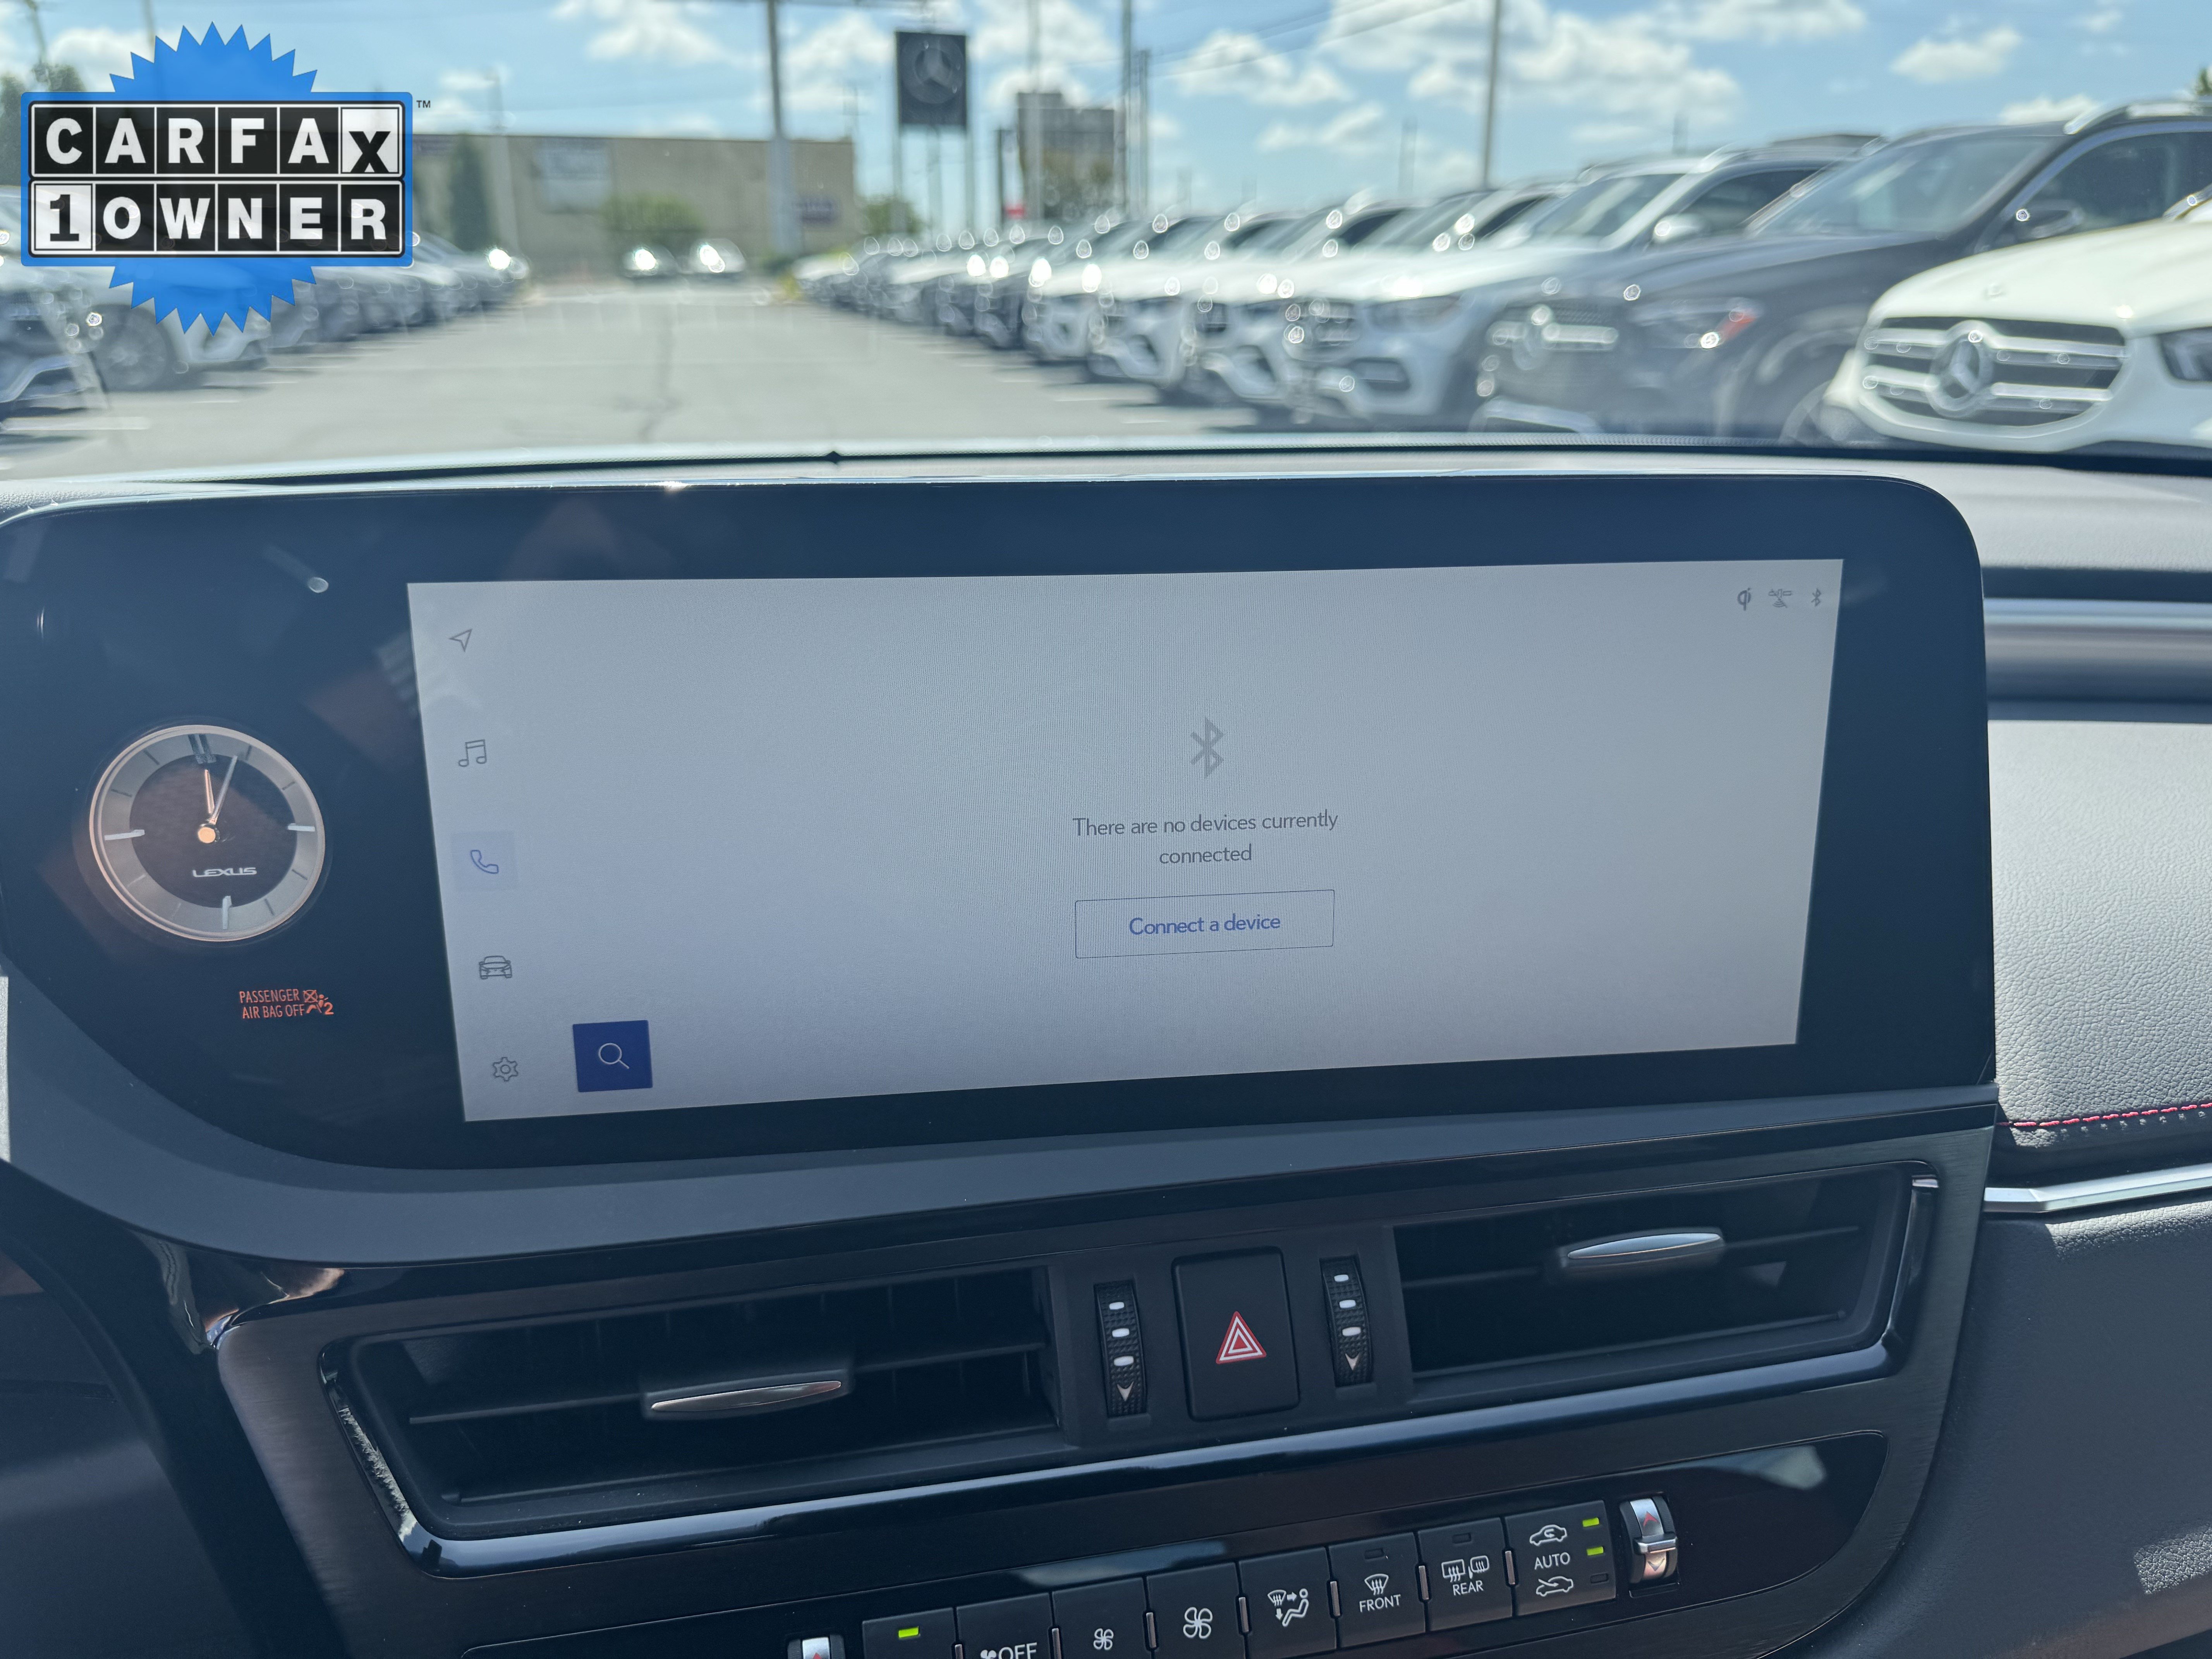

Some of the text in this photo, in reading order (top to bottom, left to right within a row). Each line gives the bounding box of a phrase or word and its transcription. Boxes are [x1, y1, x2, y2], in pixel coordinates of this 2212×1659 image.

[1072, 809, 1338, 836] There are no devices currently
[1159, 843, 1252, 864] connected
[192, 867, 257, 878] LEXUS
[1129, 914, 1281, 935] Connect a device
[239, 989, 300, 1003] PASSENGER
[242, 1004, 305, 1019] AIR BAG OFF
[1534, 1552, 1571, 1570] AUTO
[1452, 1580, 1484, 1596] REAR
[1359, 1594, 1401, 1613] FRONT
[998, 1642, 1037, 1659] OFF
